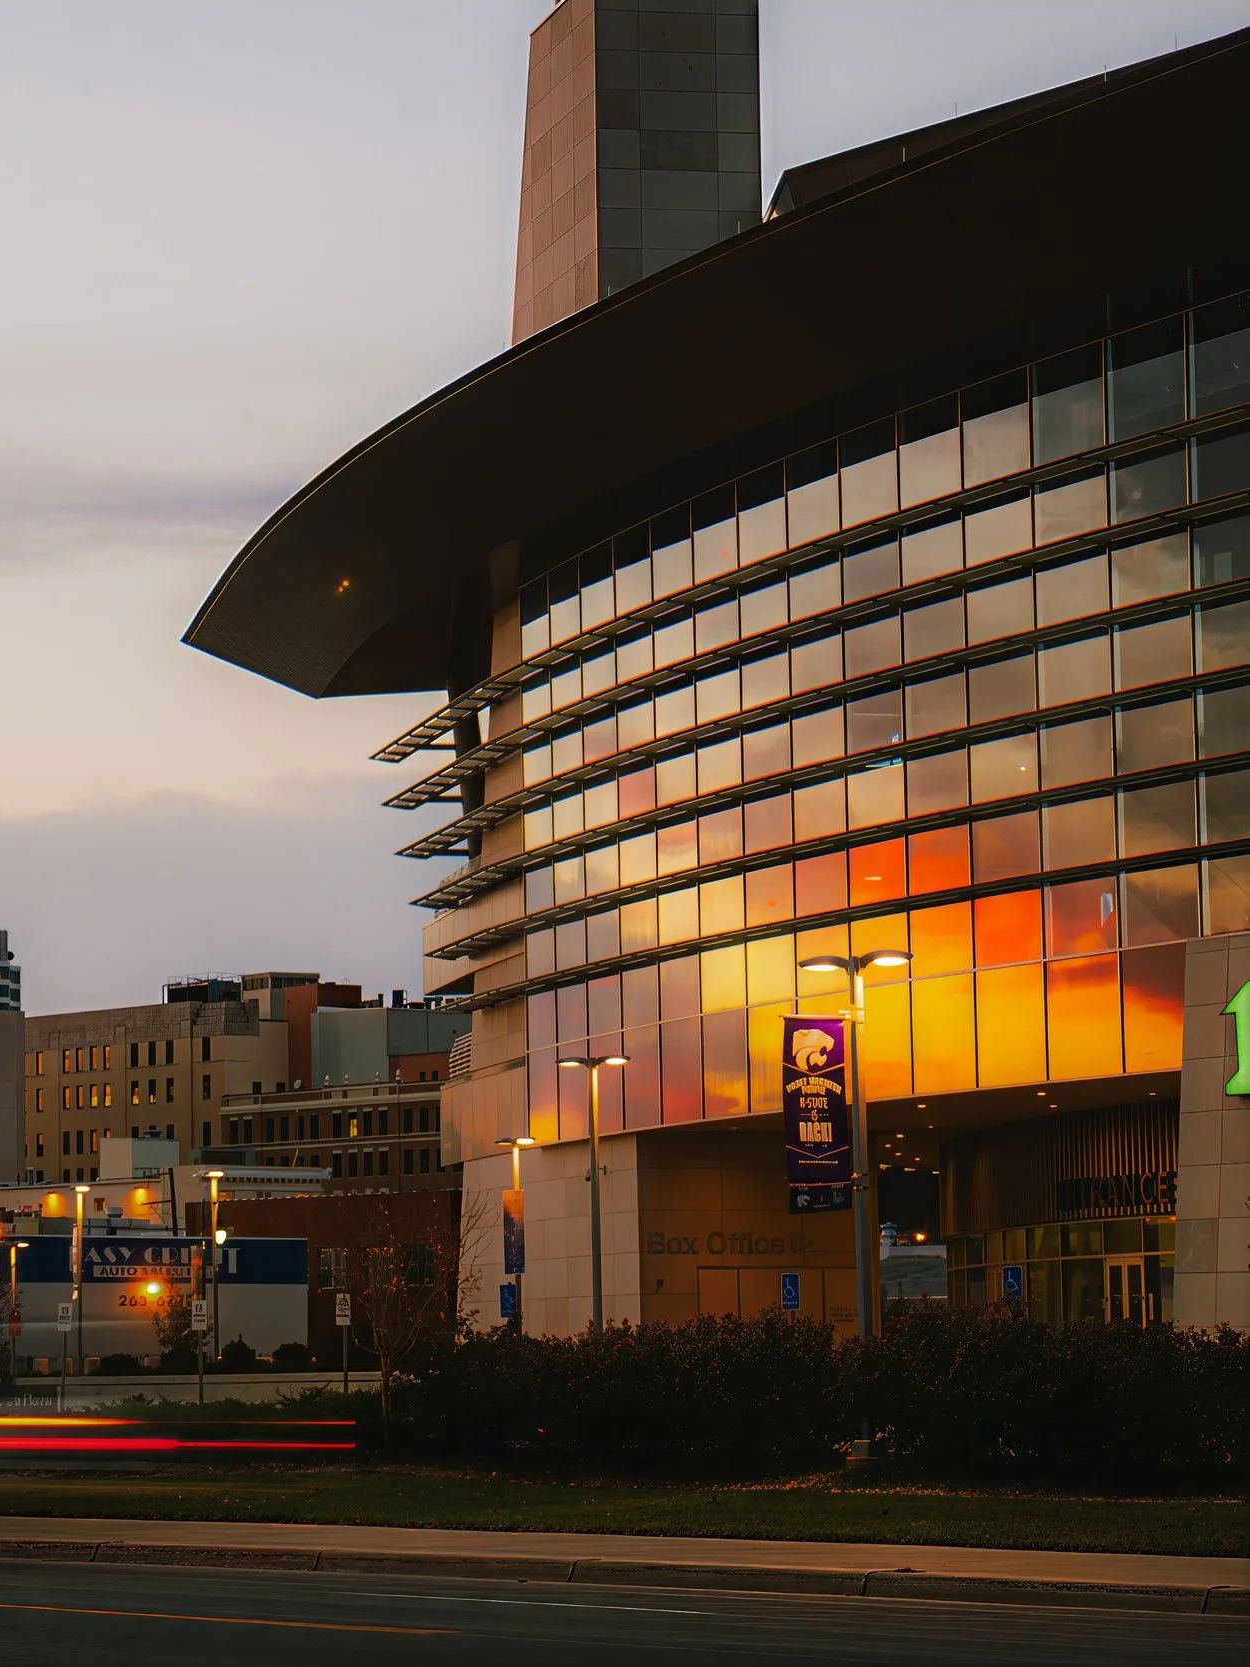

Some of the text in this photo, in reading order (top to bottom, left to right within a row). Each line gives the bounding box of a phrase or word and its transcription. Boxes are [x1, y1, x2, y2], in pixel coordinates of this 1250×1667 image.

[648, 1230, 785, 1255] Box Office
[100, 1266, 138, 1277] AUTO
